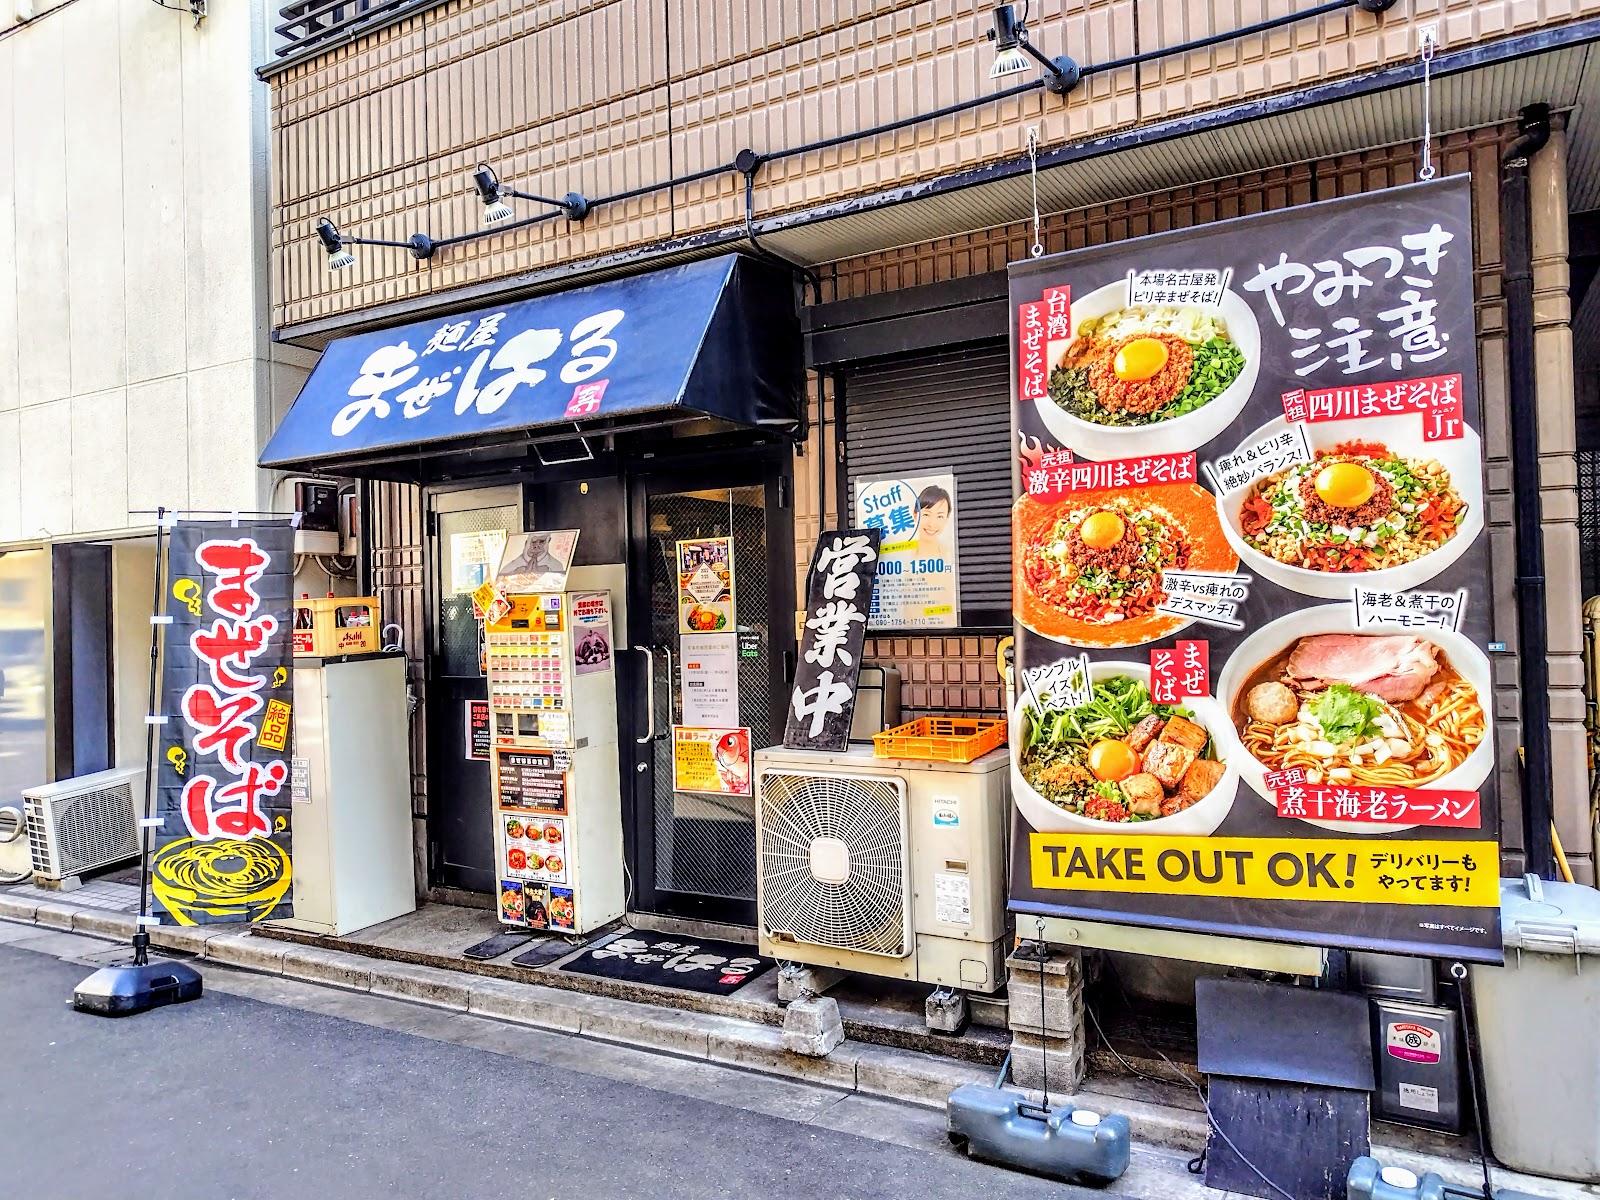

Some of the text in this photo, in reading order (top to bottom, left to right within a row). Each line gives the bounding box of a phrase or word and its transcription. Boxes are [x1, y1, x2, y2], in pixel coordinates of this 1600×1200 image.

[1139, 273, 1218, 286] 本場名古屋発
[1243, 223, 1455, 327] やみつき
[1133, 291, 1219, 303] ピリ辛まぜそば!
[1047, 290, 1068, 338] 台湾
[1290, 295, 1449, 376] 注意
[1023, 305, 1045, 396] まぜそば
[331, 308, 626, 437] まぜはる
[1285, 391, 1307, 420] 元祖
[1310, 377, 1458, 420] 四川まぜそば
[1431, 407, 1455, 415] ジュニア
[1427, 414, 1459, 439] Jr
[1042, 452, 1071, 467] 元祖
[1223, 448, 1304, 490] 絶妙バランス!
[1028, 455, 1193, 495] 激辛四川まぜそば
[863, 485, 902, 513] Staff
[863, 505, 915, 540] 募集
[1165, 577, 1245, 599] 激辛vs痺れの
[1170, 597, 1234, 616] デスマッチ!
[1368, 612, 1446, 630] ハーモニー!
[342, 631, 363, 641] Asahi
[741, 642, 759, 650] Uber
[792, 534, 877, 738] 営業中
[1031, 660, 1080, 683] シンプル
[1154, 652, 1177, 702] そば
[1180, 643, 1206, 695] まぜ
[182, 538, 288, 840] まぜそば
[1048, 679, 1071, 695] イズ
[262, 704, 287, 743] 絶品
[1268, 770, 1305, 787] 元祖
[1280, 786, 1476, 820] 煮干海老ラーメン
[1043, 845, 1357, 889] TAKE OUT OK!
[1370, 853, 1477, 871] デリバリーも
[1378, 874, 1470, 893] やってます!
